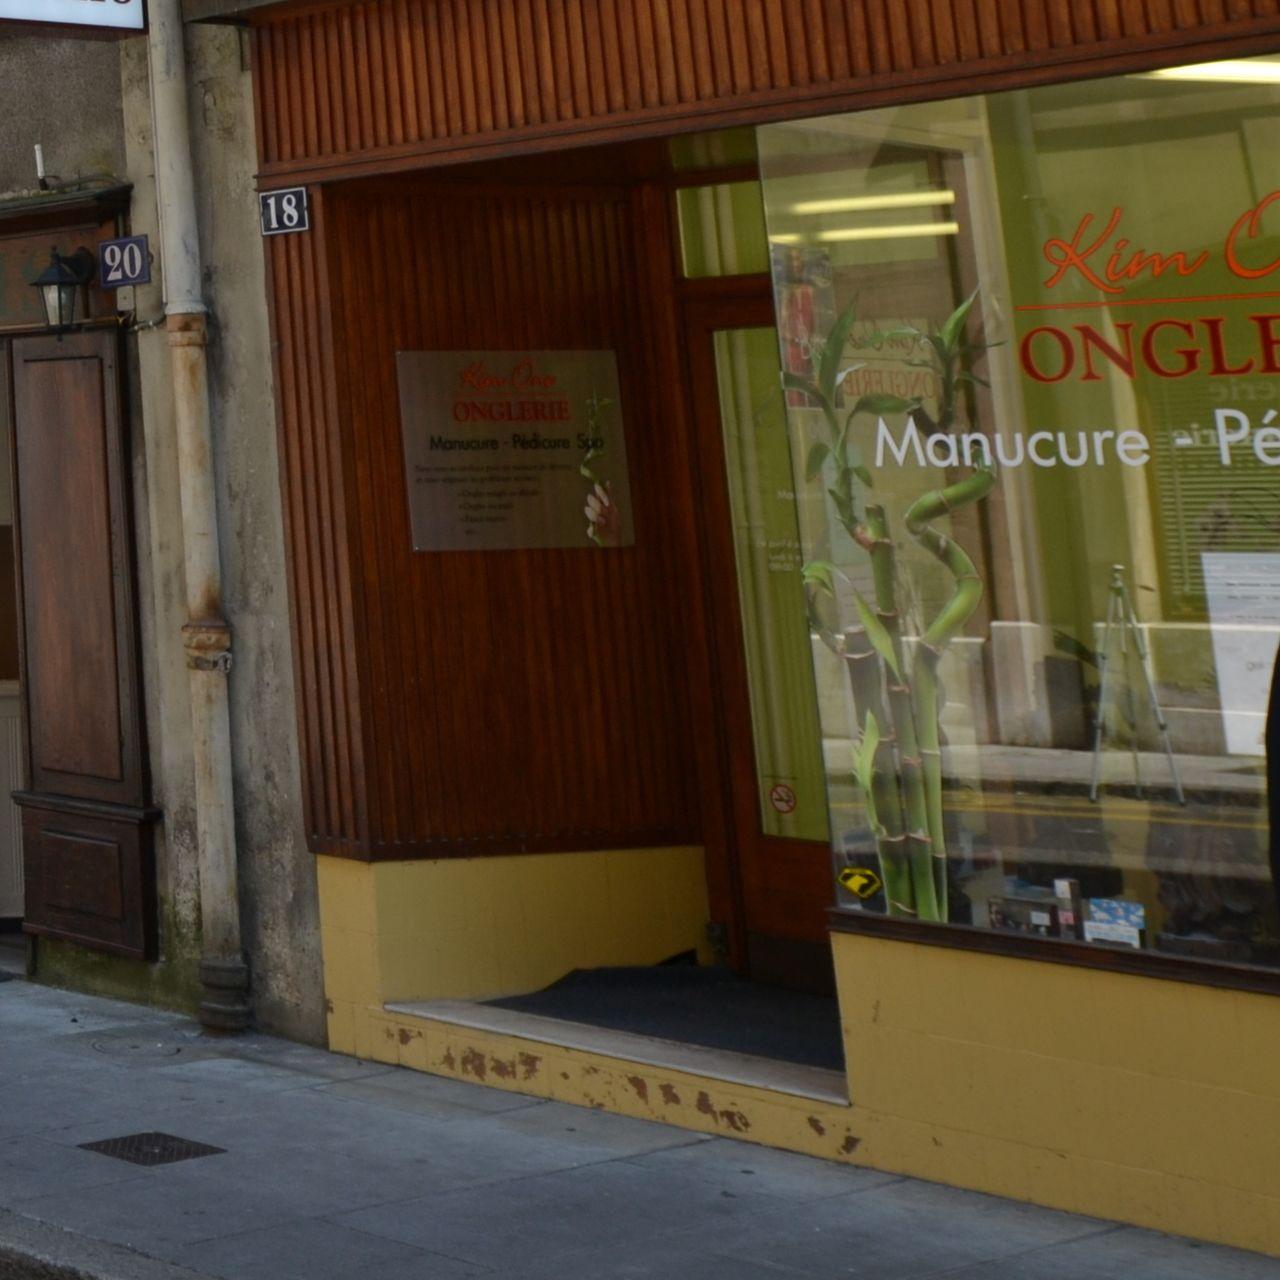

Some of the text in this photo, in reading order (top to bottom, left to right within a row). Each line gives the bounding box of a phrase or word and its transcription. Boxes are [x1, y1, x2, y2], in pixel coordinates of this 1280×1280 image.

[265, 193, 300, 230] 18
[103, 243, 143, 283] 20
[1043, 207, 1209, 295] Kim
[452, 399, 570, 423] ONGLERIE
[429, 434, 499, 451] Manucure
[874, 416, 1151, 469] Manucure
